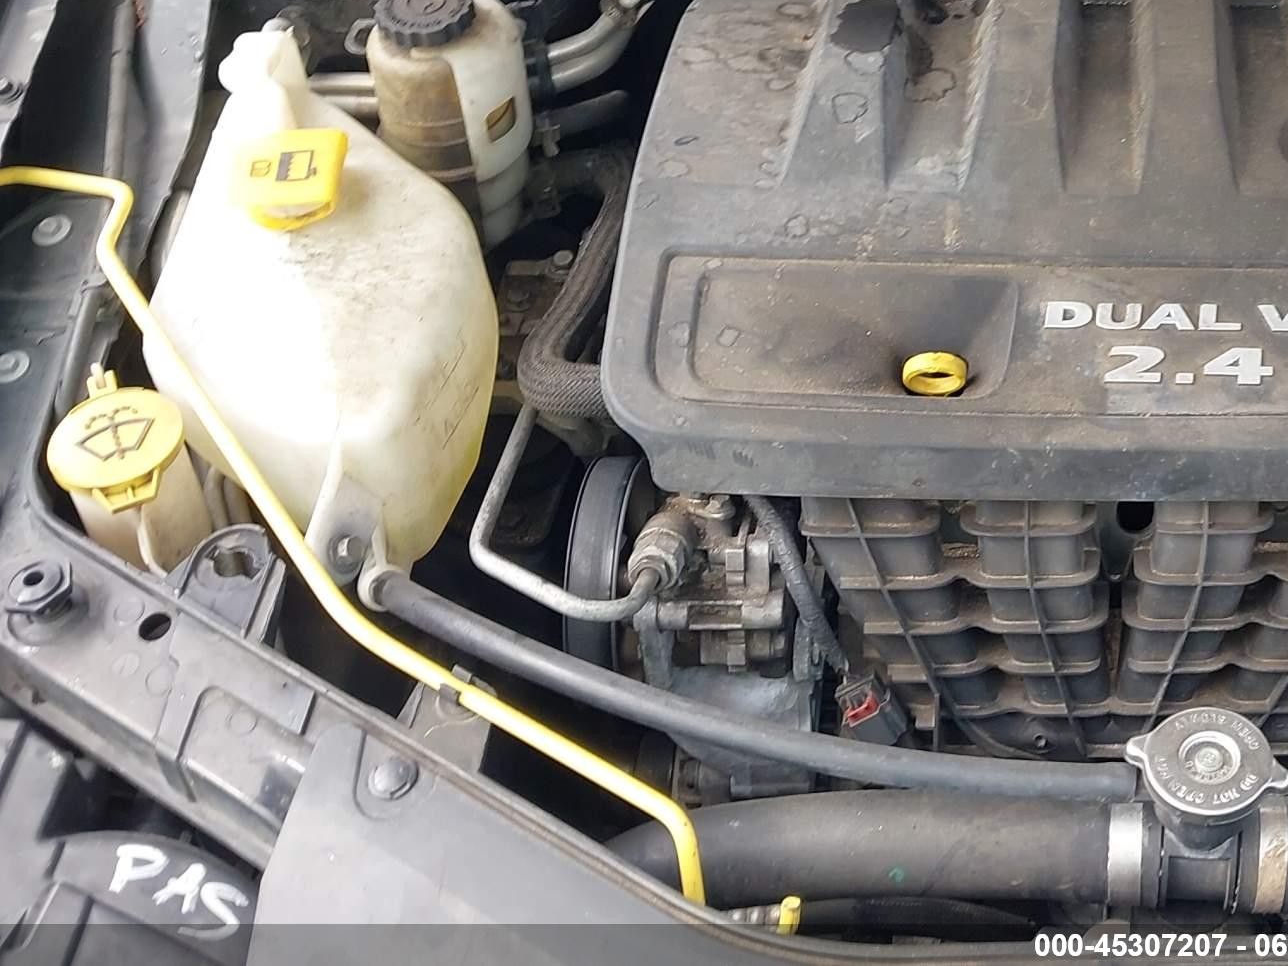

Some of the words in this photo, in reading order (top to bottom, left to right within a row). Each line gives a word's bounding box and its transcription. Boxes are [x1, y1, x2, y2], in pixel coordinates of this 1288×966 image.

[1043, 301, 1242, 331] DUAL
[1103, 346, 1274, 385] 2.4
[1212, 787, 1241, 805] NOT
[108, 844, 249, 941] PAS
